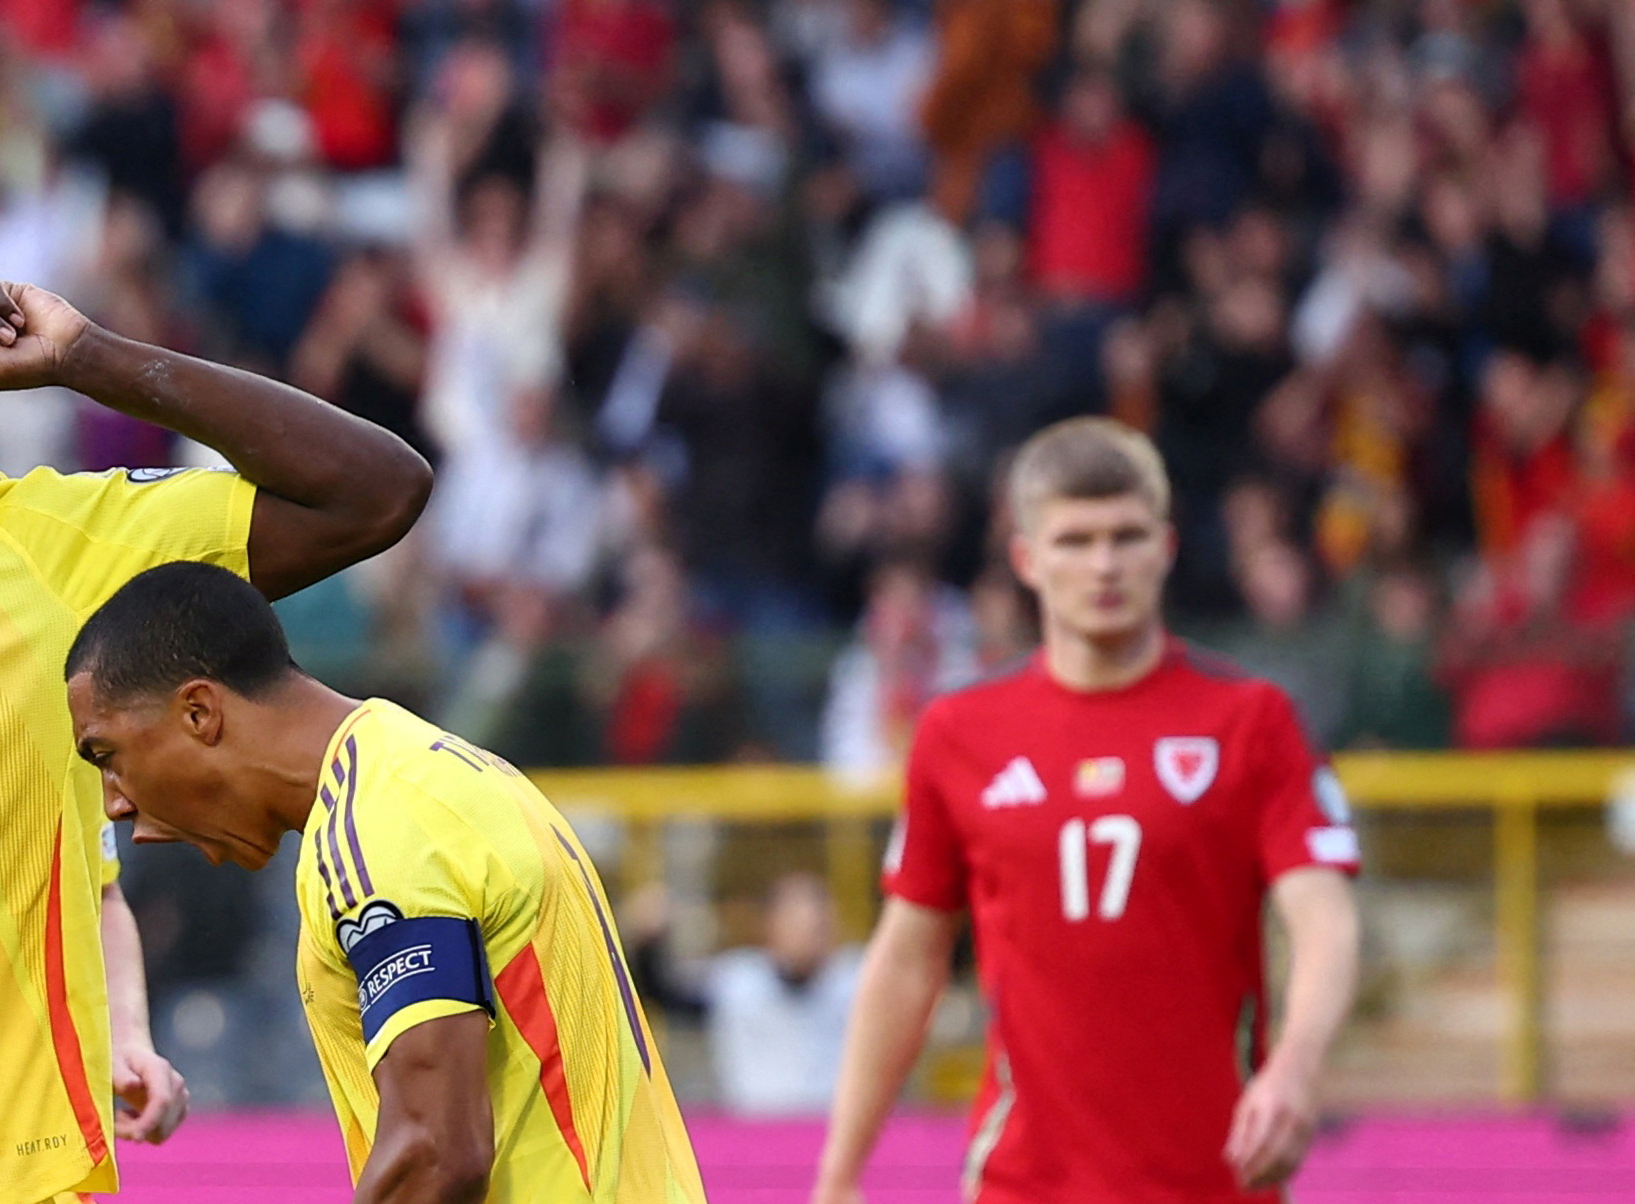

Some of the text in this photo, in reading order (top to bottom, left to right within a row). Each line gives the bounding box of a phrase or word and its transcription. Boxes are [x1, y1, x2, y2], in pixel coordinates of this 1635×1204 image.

[1058, 814, 1142, 922] 17
[367, 950, 432, 998] RESPECT
[16, 1134, 67, 1157] HEAT.RDY
